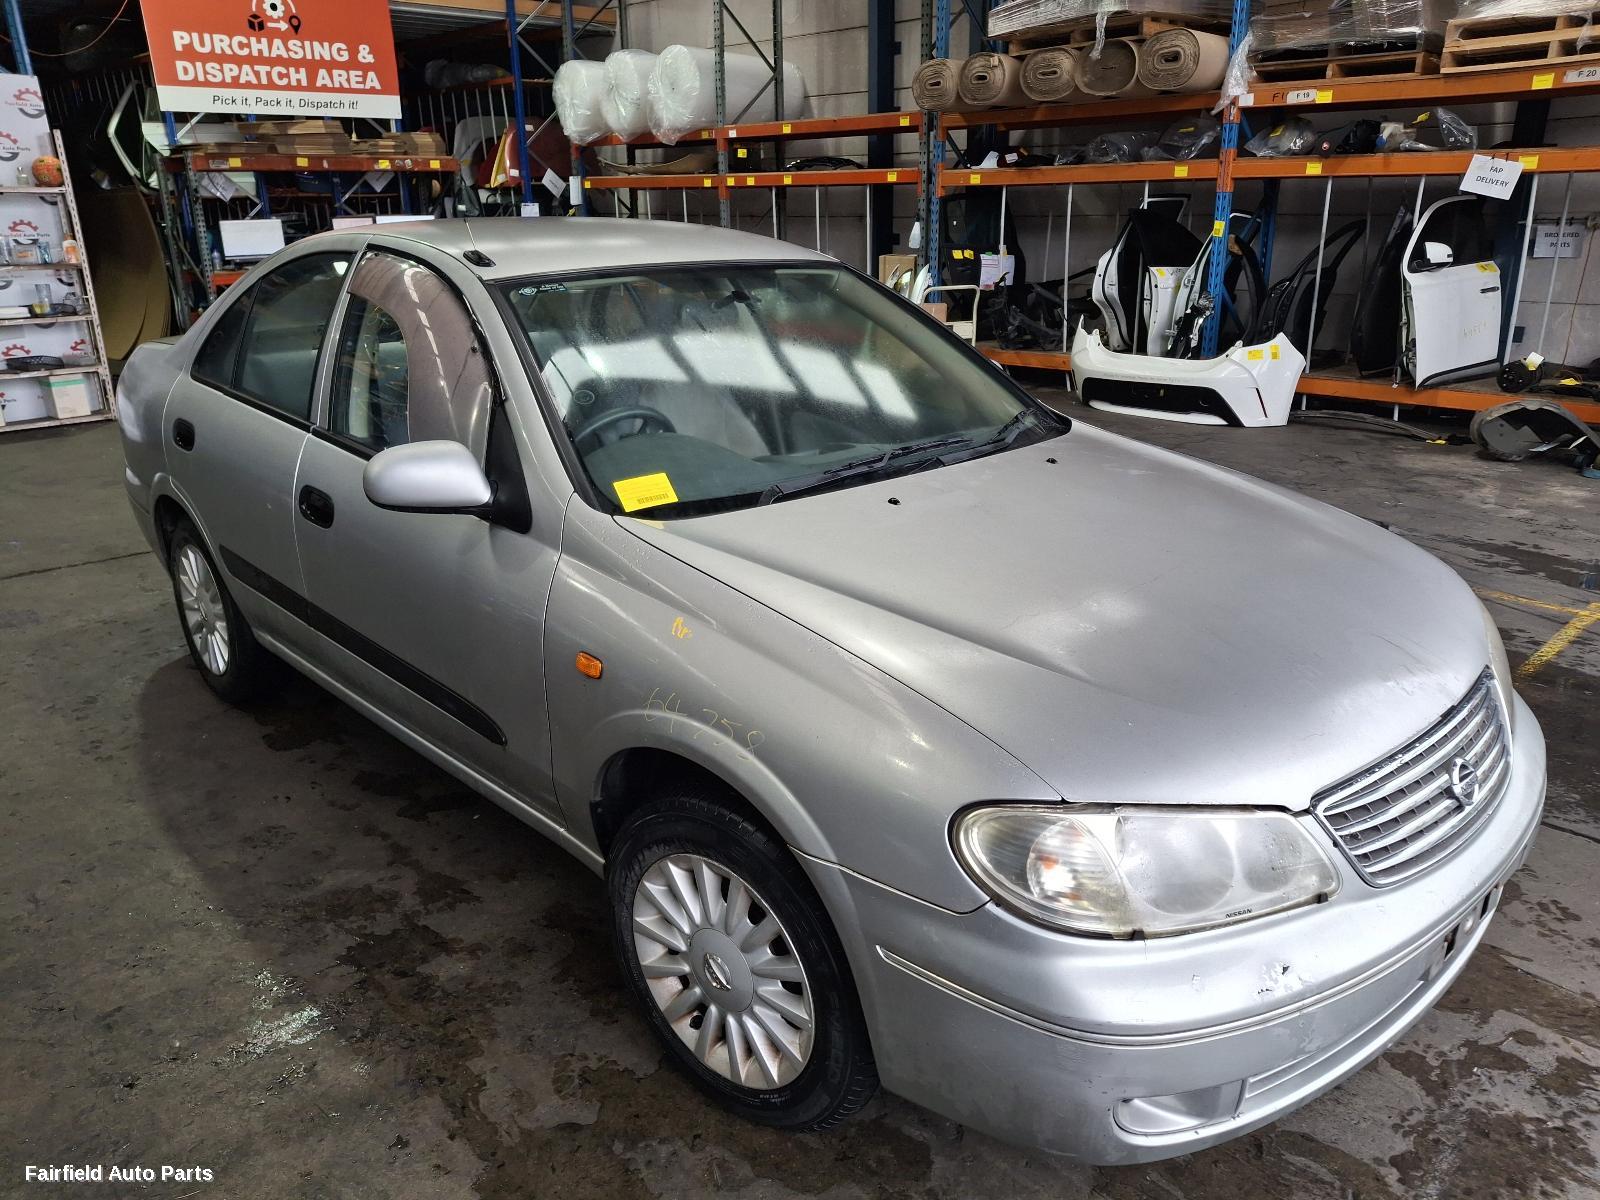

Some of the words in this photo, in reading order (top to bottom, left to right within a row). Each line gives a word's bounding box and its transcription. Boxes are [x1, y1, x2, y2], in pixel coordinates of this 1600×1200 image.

[172, 31, 349, 62] PURCHASING
[357, 44, 375, 64] &
[175, 60, 308, 87] DISPATCH
[315, 68, 382, 90] AREA
[1577, 70, 1584, 78] F
[1585, 69, 1597, 77] 20
[1302, 91, 1310, 99] 19
[212, 95, 238, 106] Pick
[241, 95, 251, 108] it,
[255, 96, 282, 108] Pack
[285, 97, 295, 109] it,
[298, 98, 345, 111] Dispatch
[348, 99, 358, 110] it!
[1489, 165, 1504, 174] FAP
[1475, 175, 1510, 188] DELIVERY
[1225, 908, 1253, 919] NISSAN
